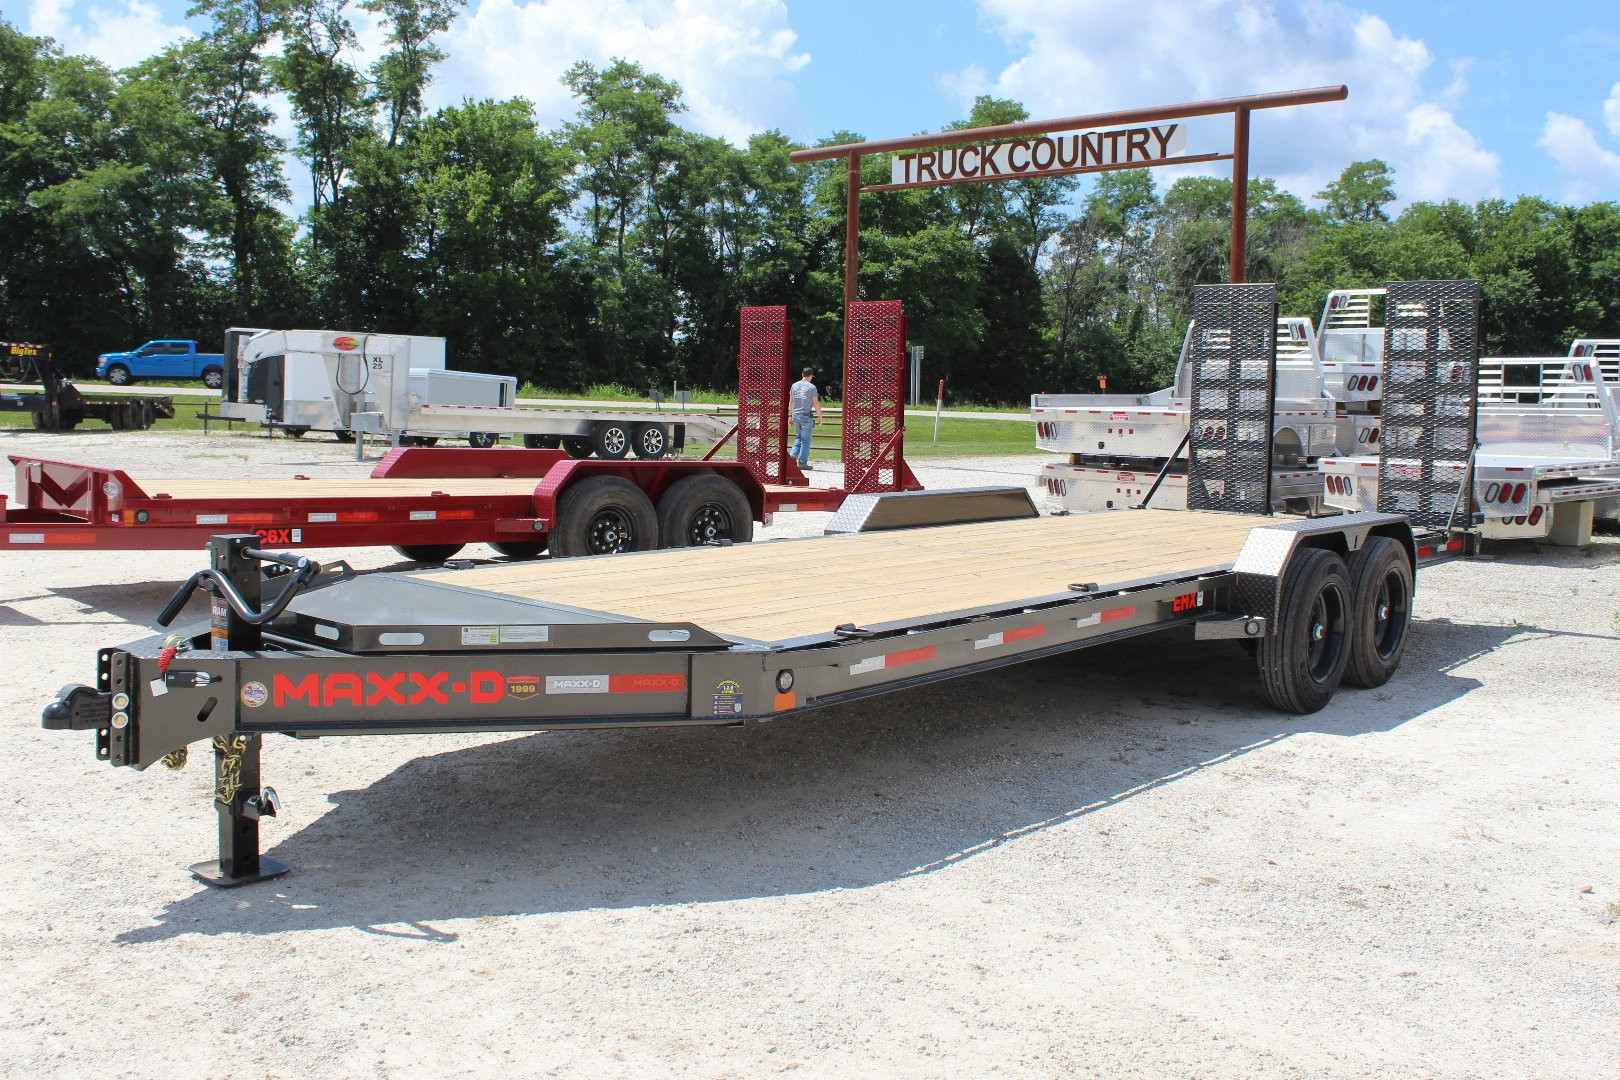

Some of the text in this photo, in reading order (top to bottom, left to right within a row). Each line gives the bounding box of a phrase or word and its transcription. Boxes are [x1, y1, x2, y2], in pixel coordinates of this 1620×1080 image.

[899, 123, 1179, 184] TRUCK COUNTRY
[372, 356, 384, 364] XL
[255, 528, 290, 545] C6X
[211, 605, 228, 617] RAM
[273, 669, 505, 707] MAXX-D
[553, 679, 601, 689] MAXX-D
[633, 678, 679, 687] MAXX-D
[510, 684, 536, 694] 1999
